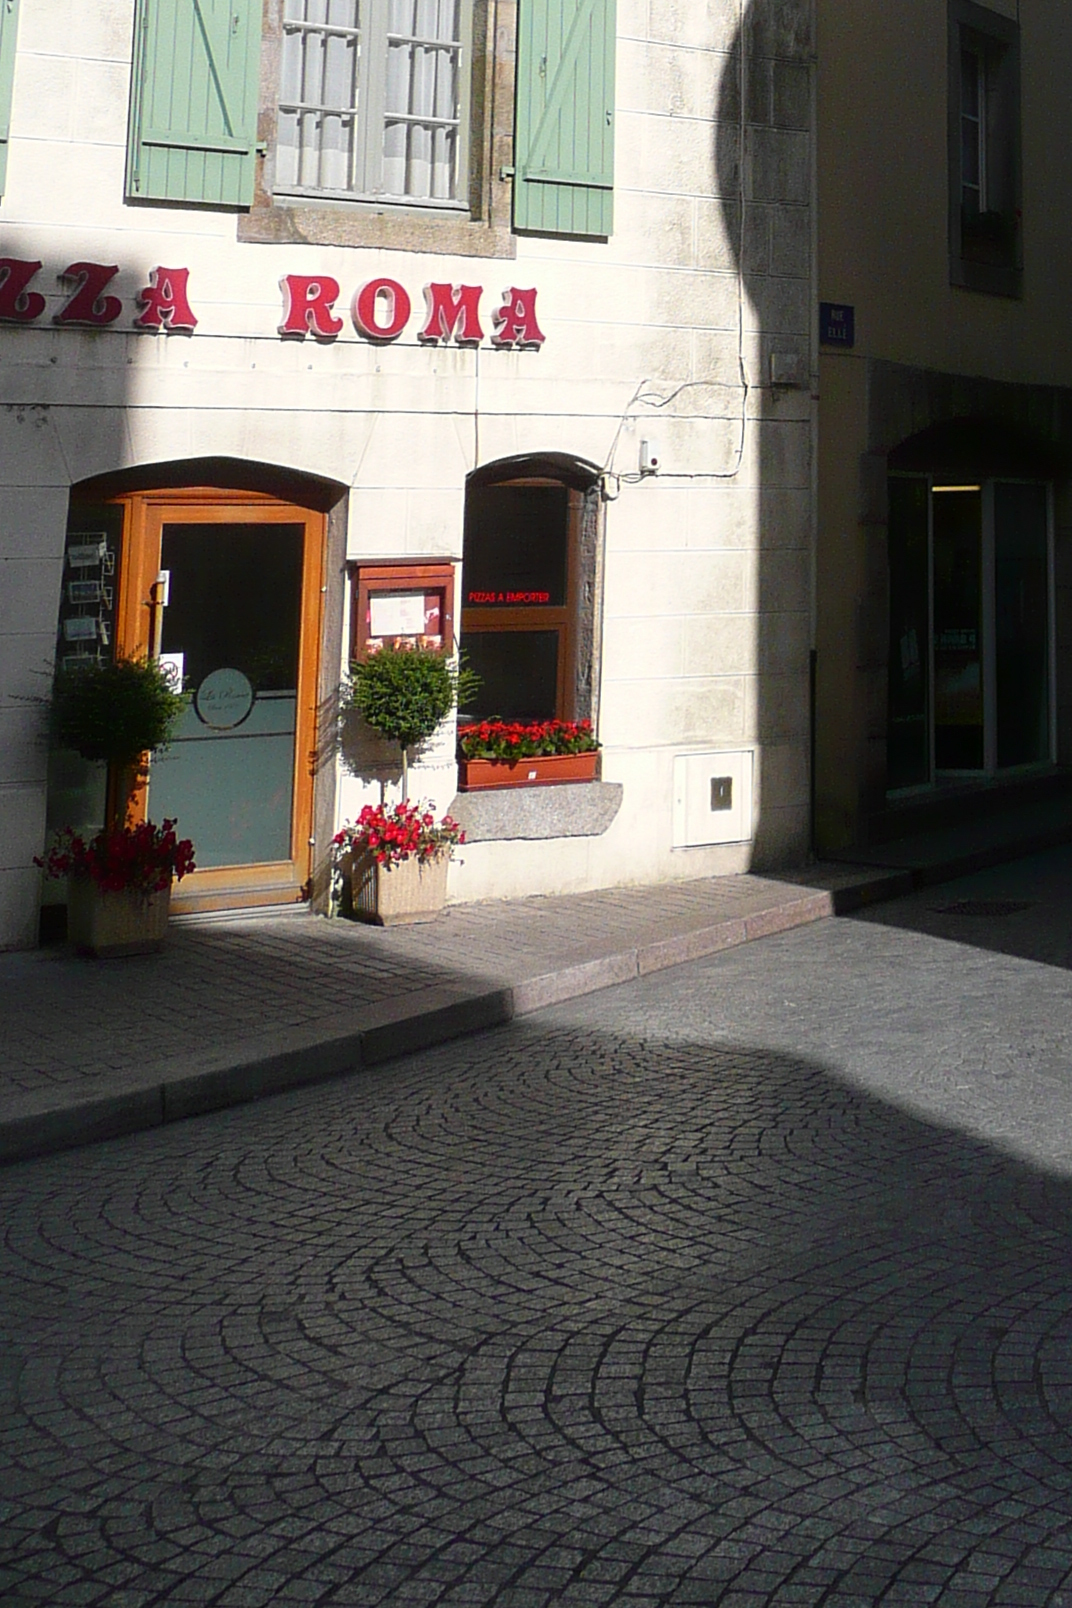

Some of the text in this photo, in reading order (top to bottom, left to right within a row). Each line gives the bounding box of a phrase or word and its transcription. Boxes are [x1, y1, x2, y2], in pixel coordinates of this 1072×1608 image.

[278, 274, 547, 346] ROMA
[831, 309, 844, 321] RUE
[469, 591, 549, 603] PIZZAS A EMPORTER
